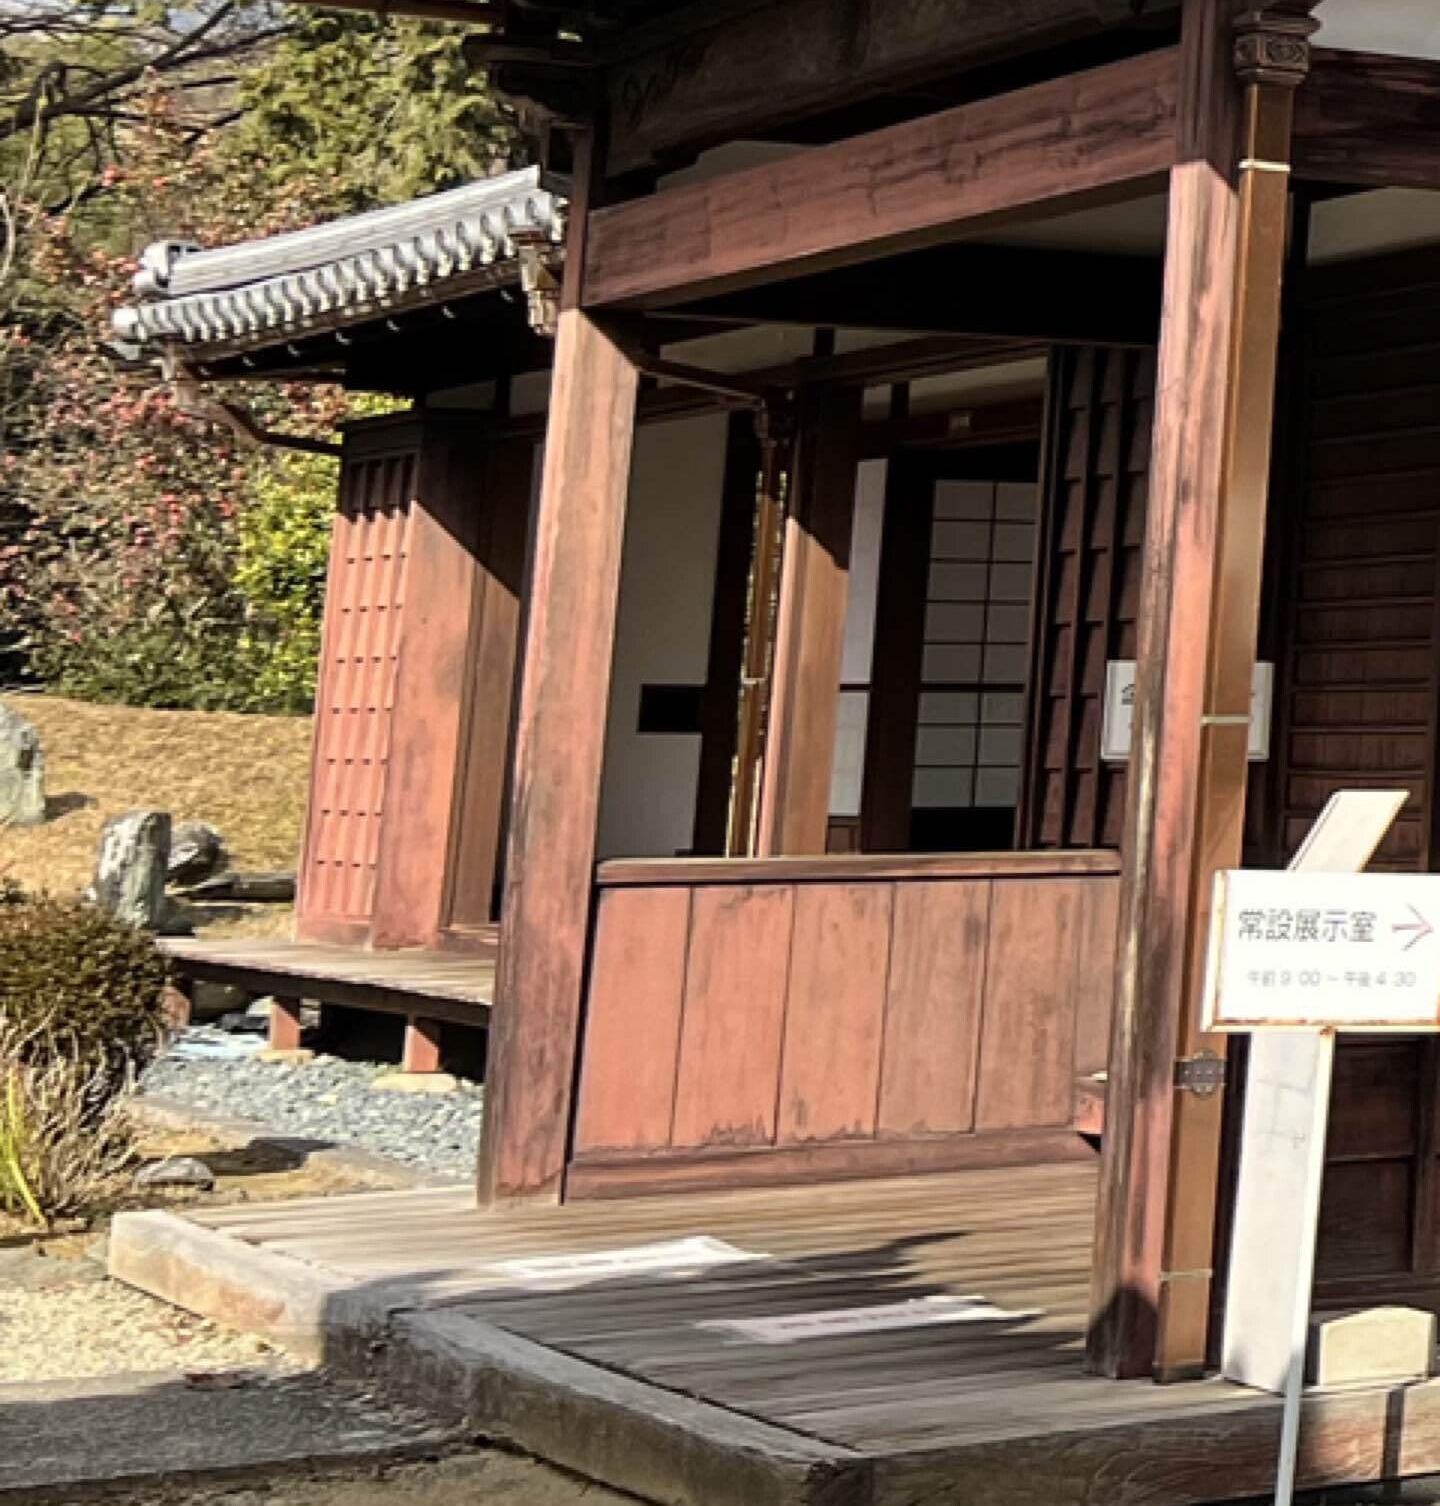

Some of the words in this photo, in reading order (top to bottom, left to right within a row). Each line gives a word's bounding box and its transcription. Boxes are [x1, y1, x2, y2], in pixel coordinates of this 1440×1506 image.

[1237, 909, 1377, 943] 常設展示室
